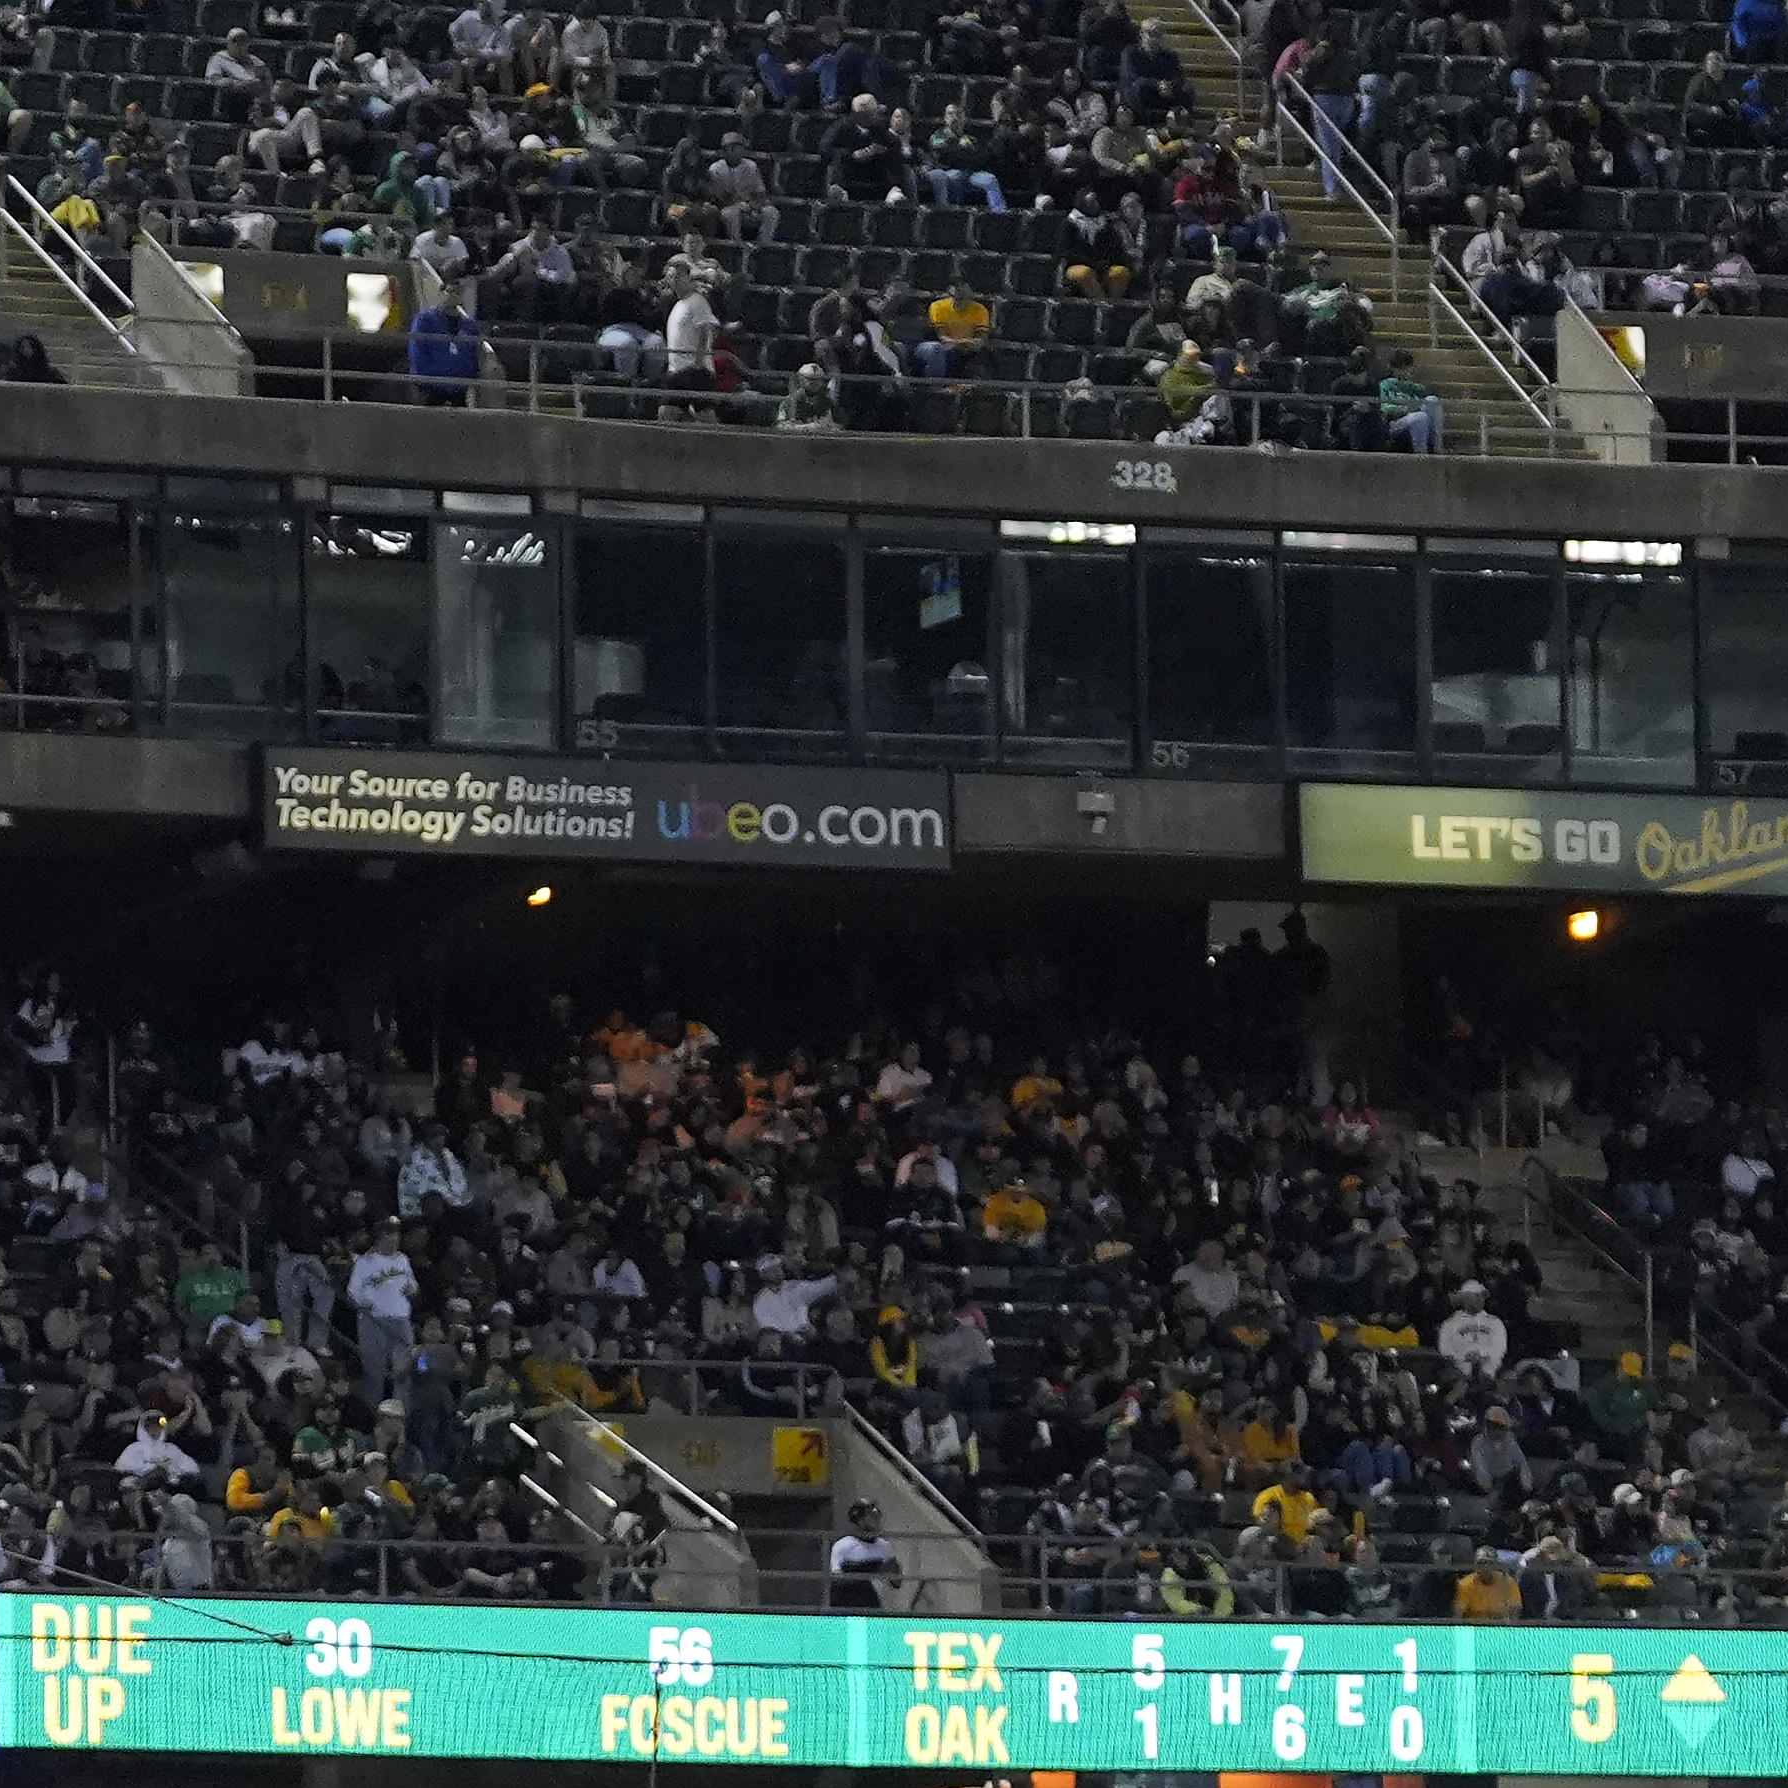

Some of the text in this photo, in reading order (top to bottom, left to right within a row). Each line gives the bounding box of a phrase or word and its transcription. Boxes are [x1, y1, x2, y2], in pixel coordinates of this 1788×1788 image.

[1114, 460, 1174, 491] 328
[273, 766, 632, 806] Your Source for Business
[275, 798, 635, 842] Technology Solutions!
[1412, 814, 1543, 863] LET'S
[1554, 818, 1621, 865] GO
[31, 1603, 154, 1676] DUE
[305, 1616, 373, 1678] 30
[648, 1625, 715, 1686] 56
[904, 1631, 1419, 1693] TEX 5 7 1
[42, 1677, 126, 1746] UP
[271, 1687, 412, 1749] LOWE
[600, 1693, 790, 1758] FOSCUE
[1047, 1670, 1365, 1727] R H E
[1570, 1653, 1617, 1744] 5
[904, 1702, 1424, 1765] OAK 1 6 0
